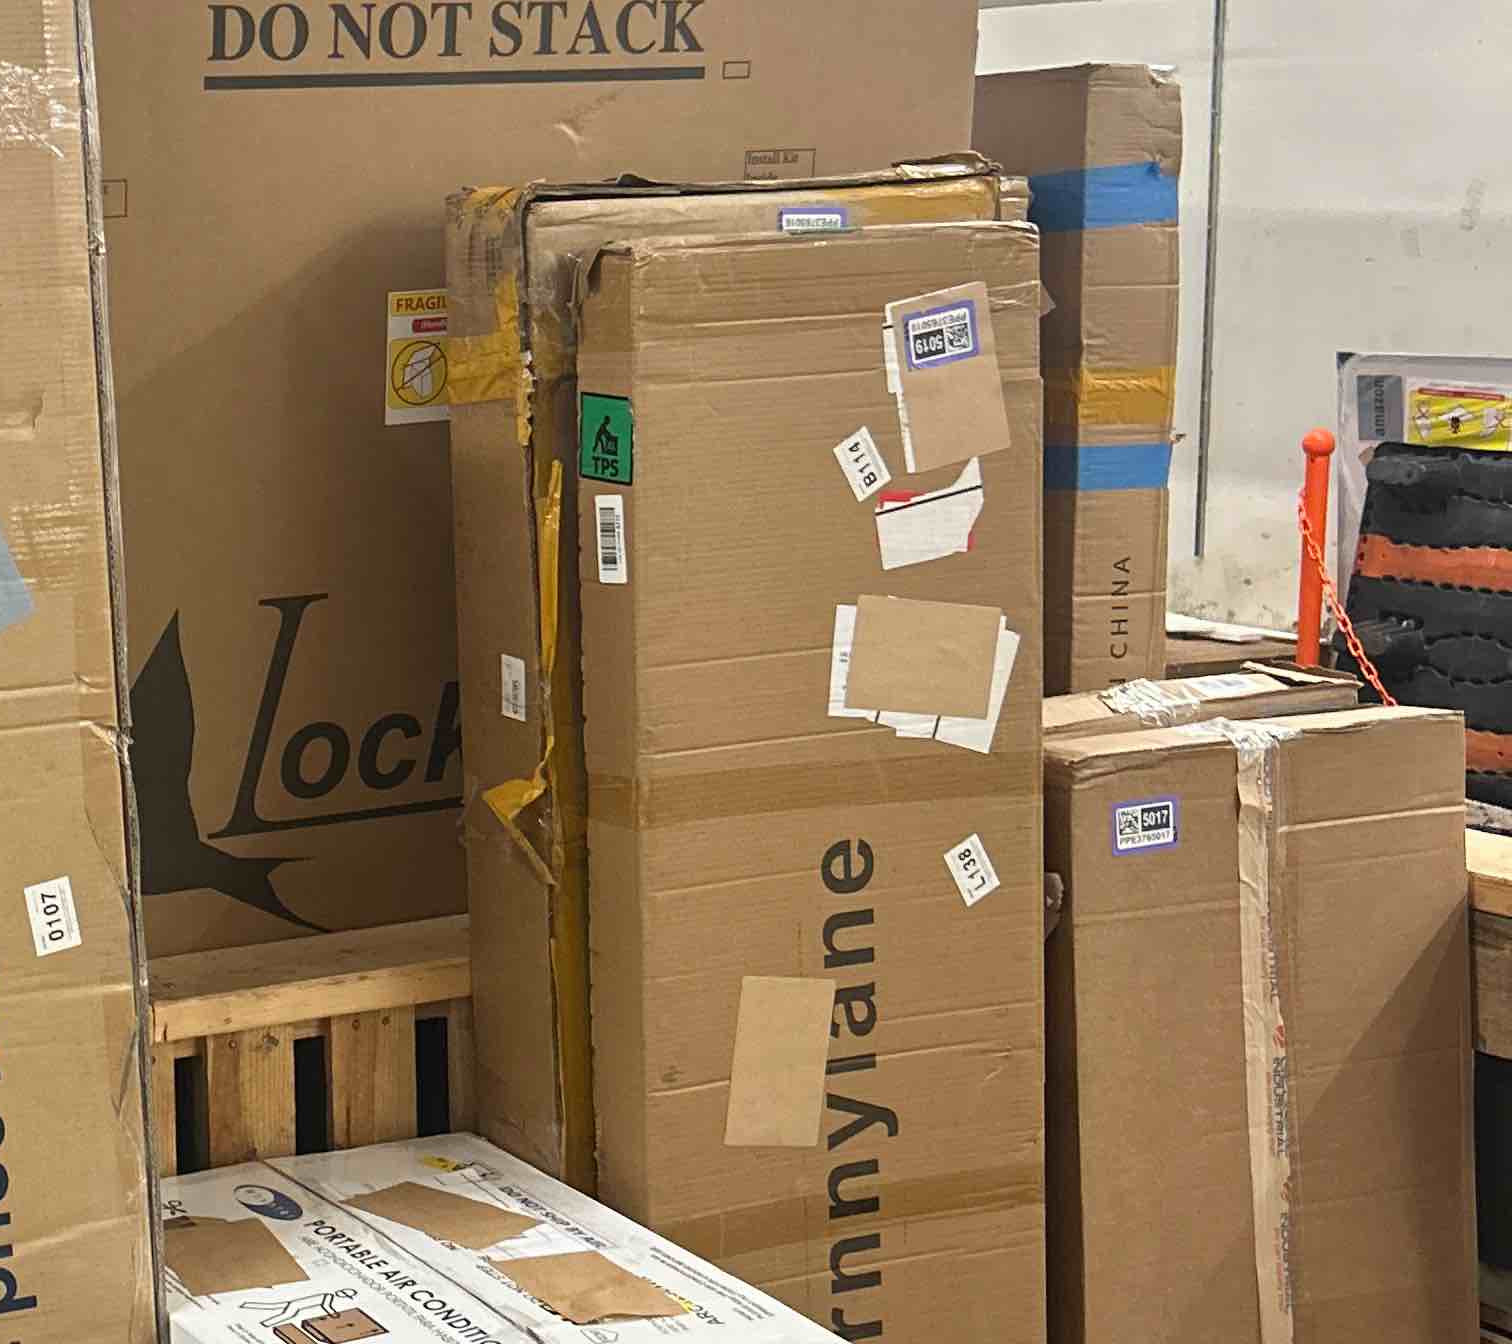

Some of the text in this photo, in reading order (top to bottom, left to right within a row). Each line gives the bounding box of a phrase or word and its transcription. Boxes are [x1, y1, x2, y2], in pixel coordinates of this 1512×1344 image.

[207, 0, 705, 62] DO NOT STACK
[395, 294, 449, 314] FRAGIL
[915, 332, 944, 354] 5019
[1373, 375, 1386, 438] amazon
[592, 457, 620, 478] TPS
[849, 441, 878, 490] B114
[1110, 555, 1132, 660] CHINA
[1143, 808, 1170, 828] 5017
[956, 846, 986, 892] L138
[39, 891, 66, 943] 0107
[304, 1218, 385, 1271] PORTABLE
[381, 1269, 417, 1290] AIR
